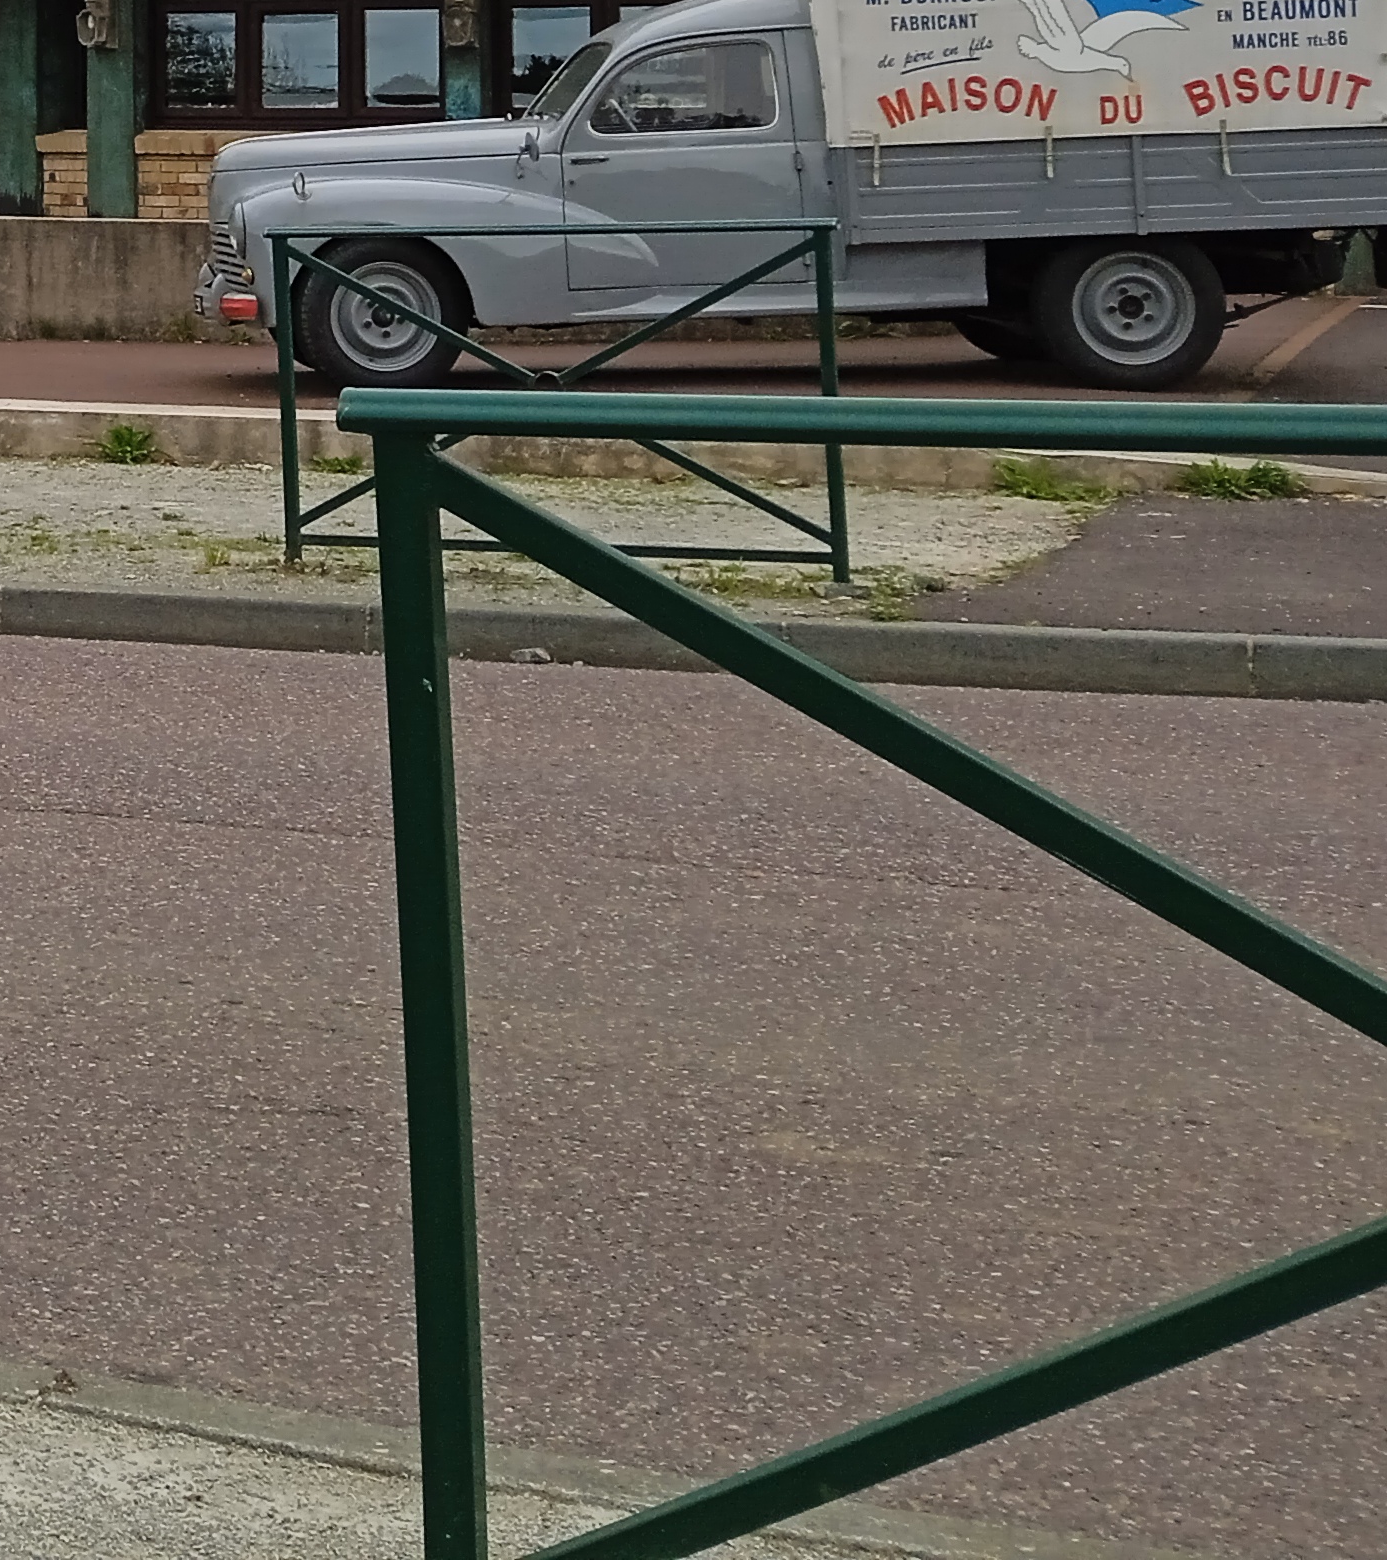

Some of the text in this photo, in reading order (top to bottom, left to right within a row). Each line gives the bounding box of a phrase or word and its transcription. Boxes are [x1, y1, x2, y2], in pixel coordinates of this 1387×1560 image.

[890, 13, 979, 32] FABRICANT
[1217, 9, 1233, 23] EN
[1232, 31, 1300, 50] MANCHE
[877, 53, 896, 69] de
[942, 46, 959, 58] en
[968, 35, 994, 57] fils
[877, 65, 1373, 129] MAISON DU BISCUIT
